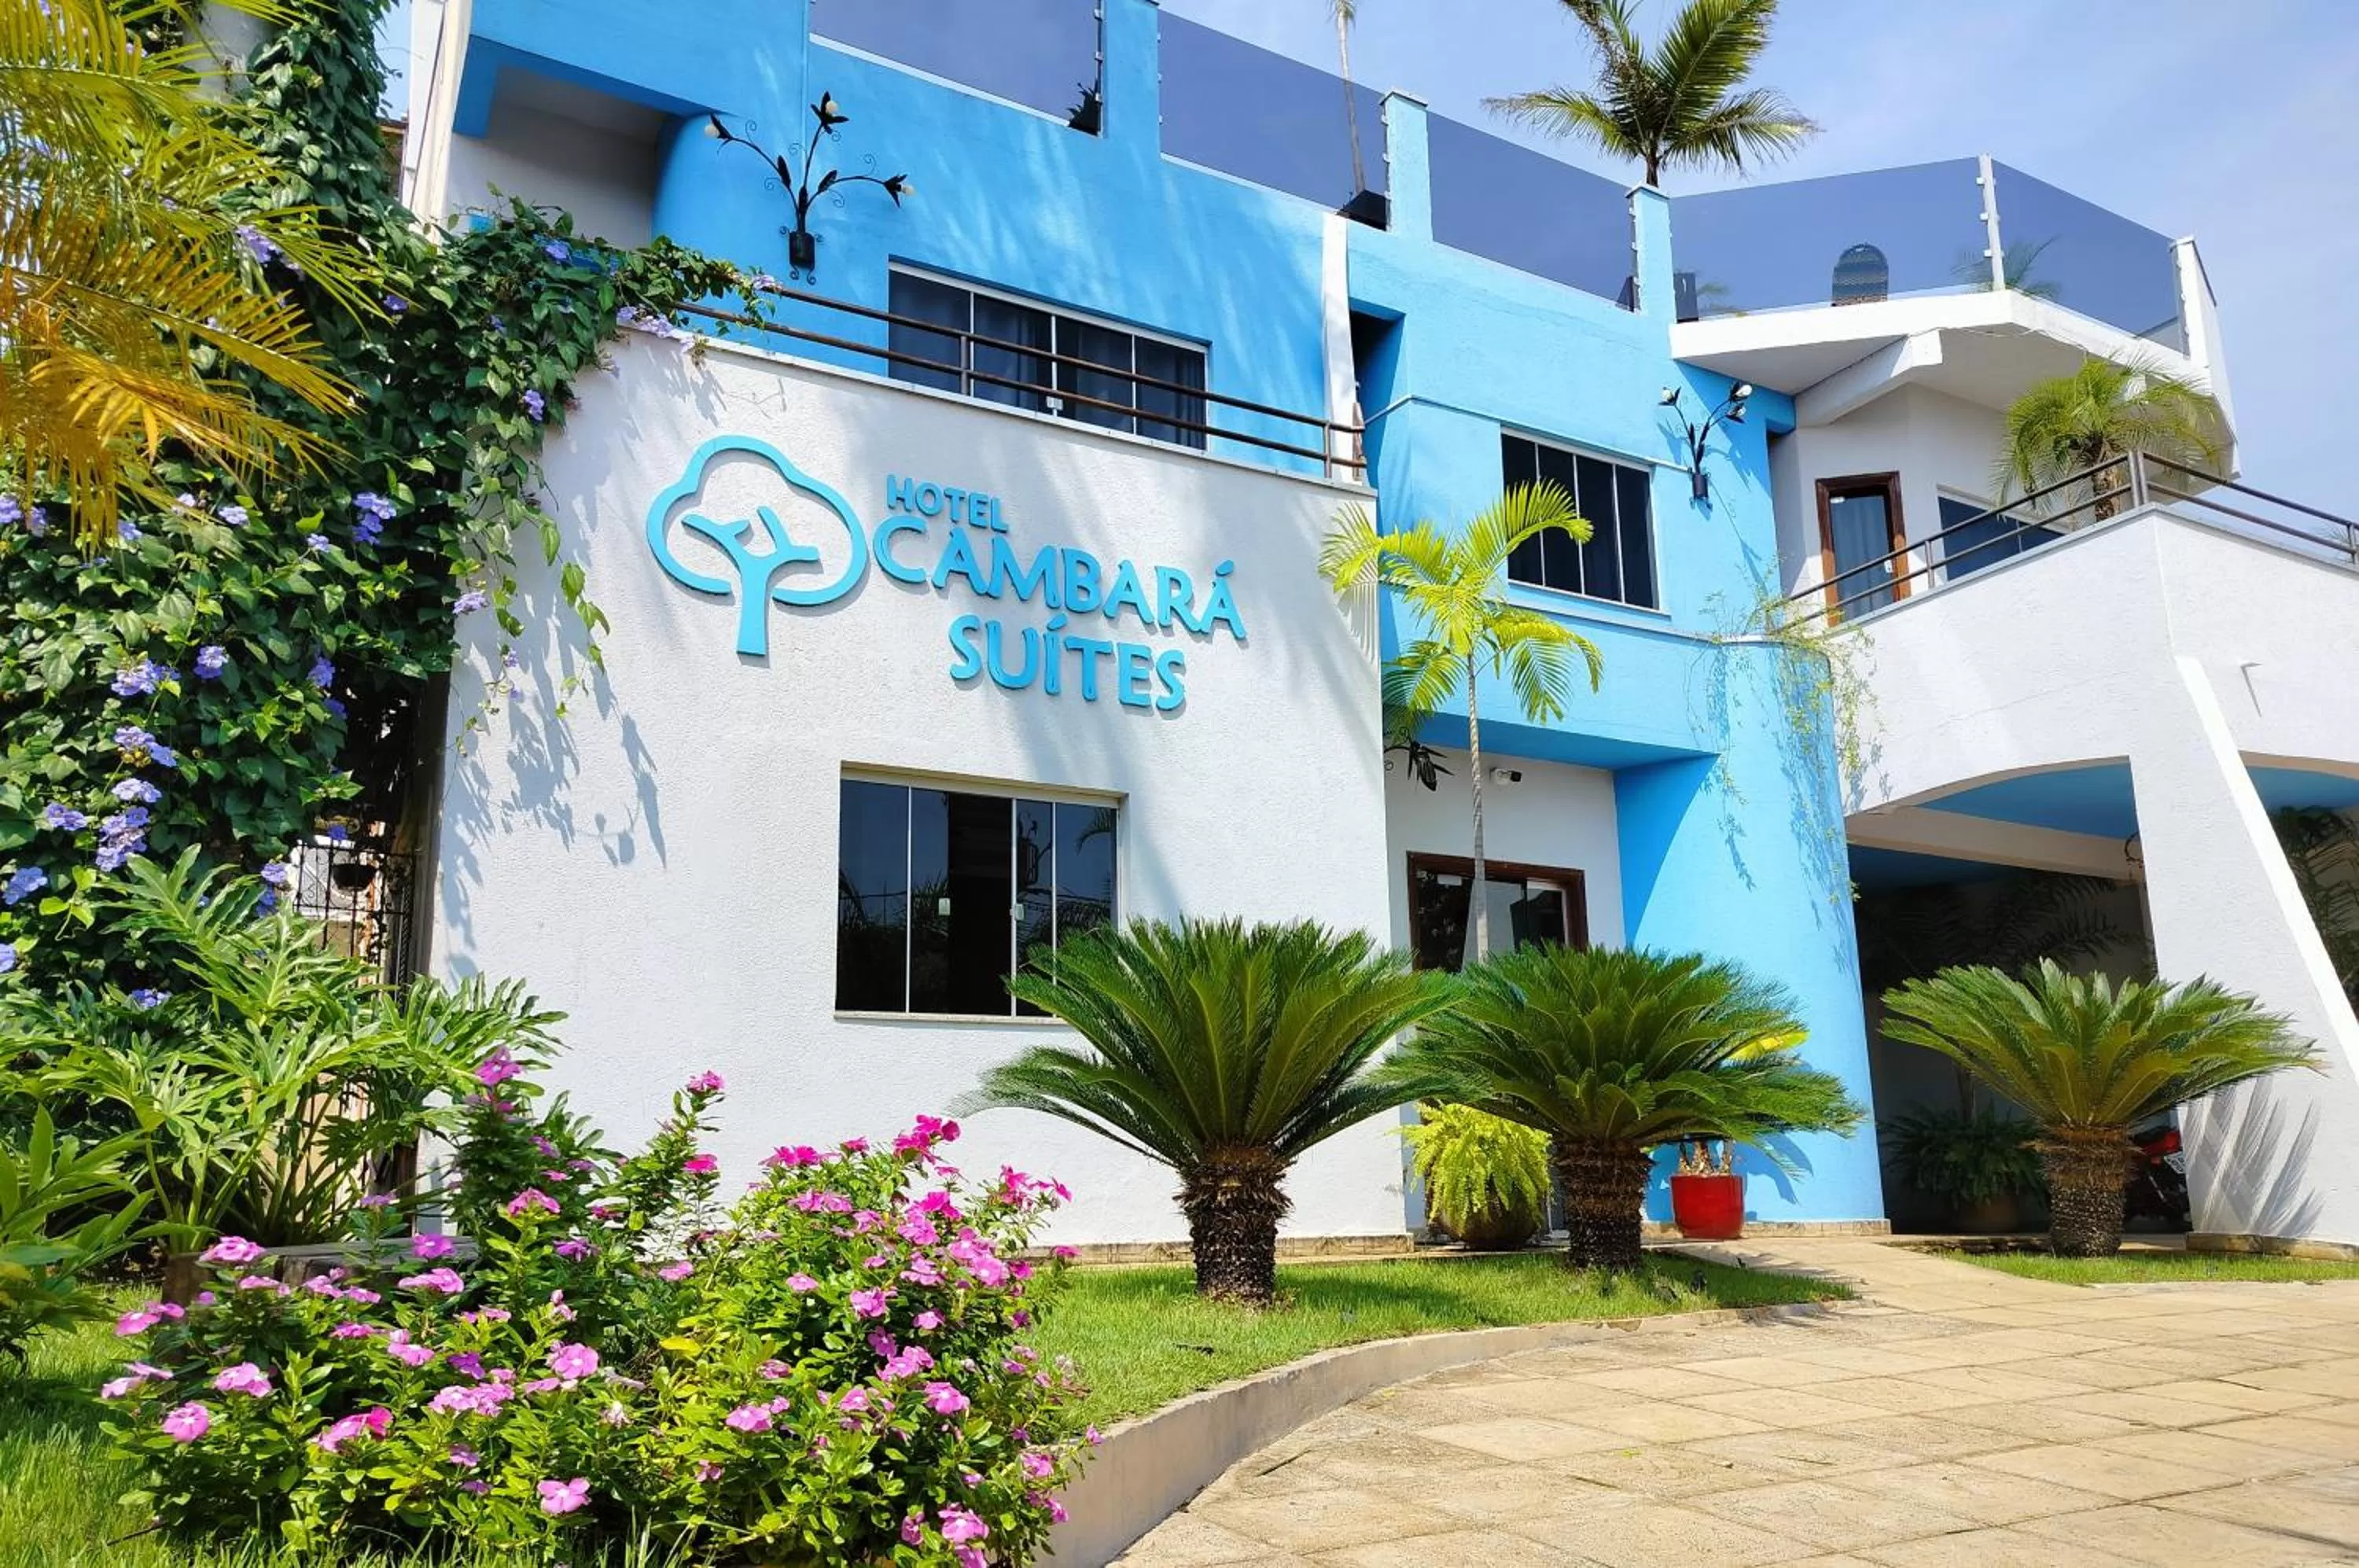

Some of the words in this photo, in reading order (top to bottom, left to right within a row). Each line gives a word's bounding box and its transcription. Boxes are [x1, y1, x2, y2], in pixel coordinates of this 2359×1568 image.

[887, 474, 1010, 532] HOTEL
[874, 517, 1246, 640] CAMBARÁ
[949, 613, 1185, 711] SUÍTES
